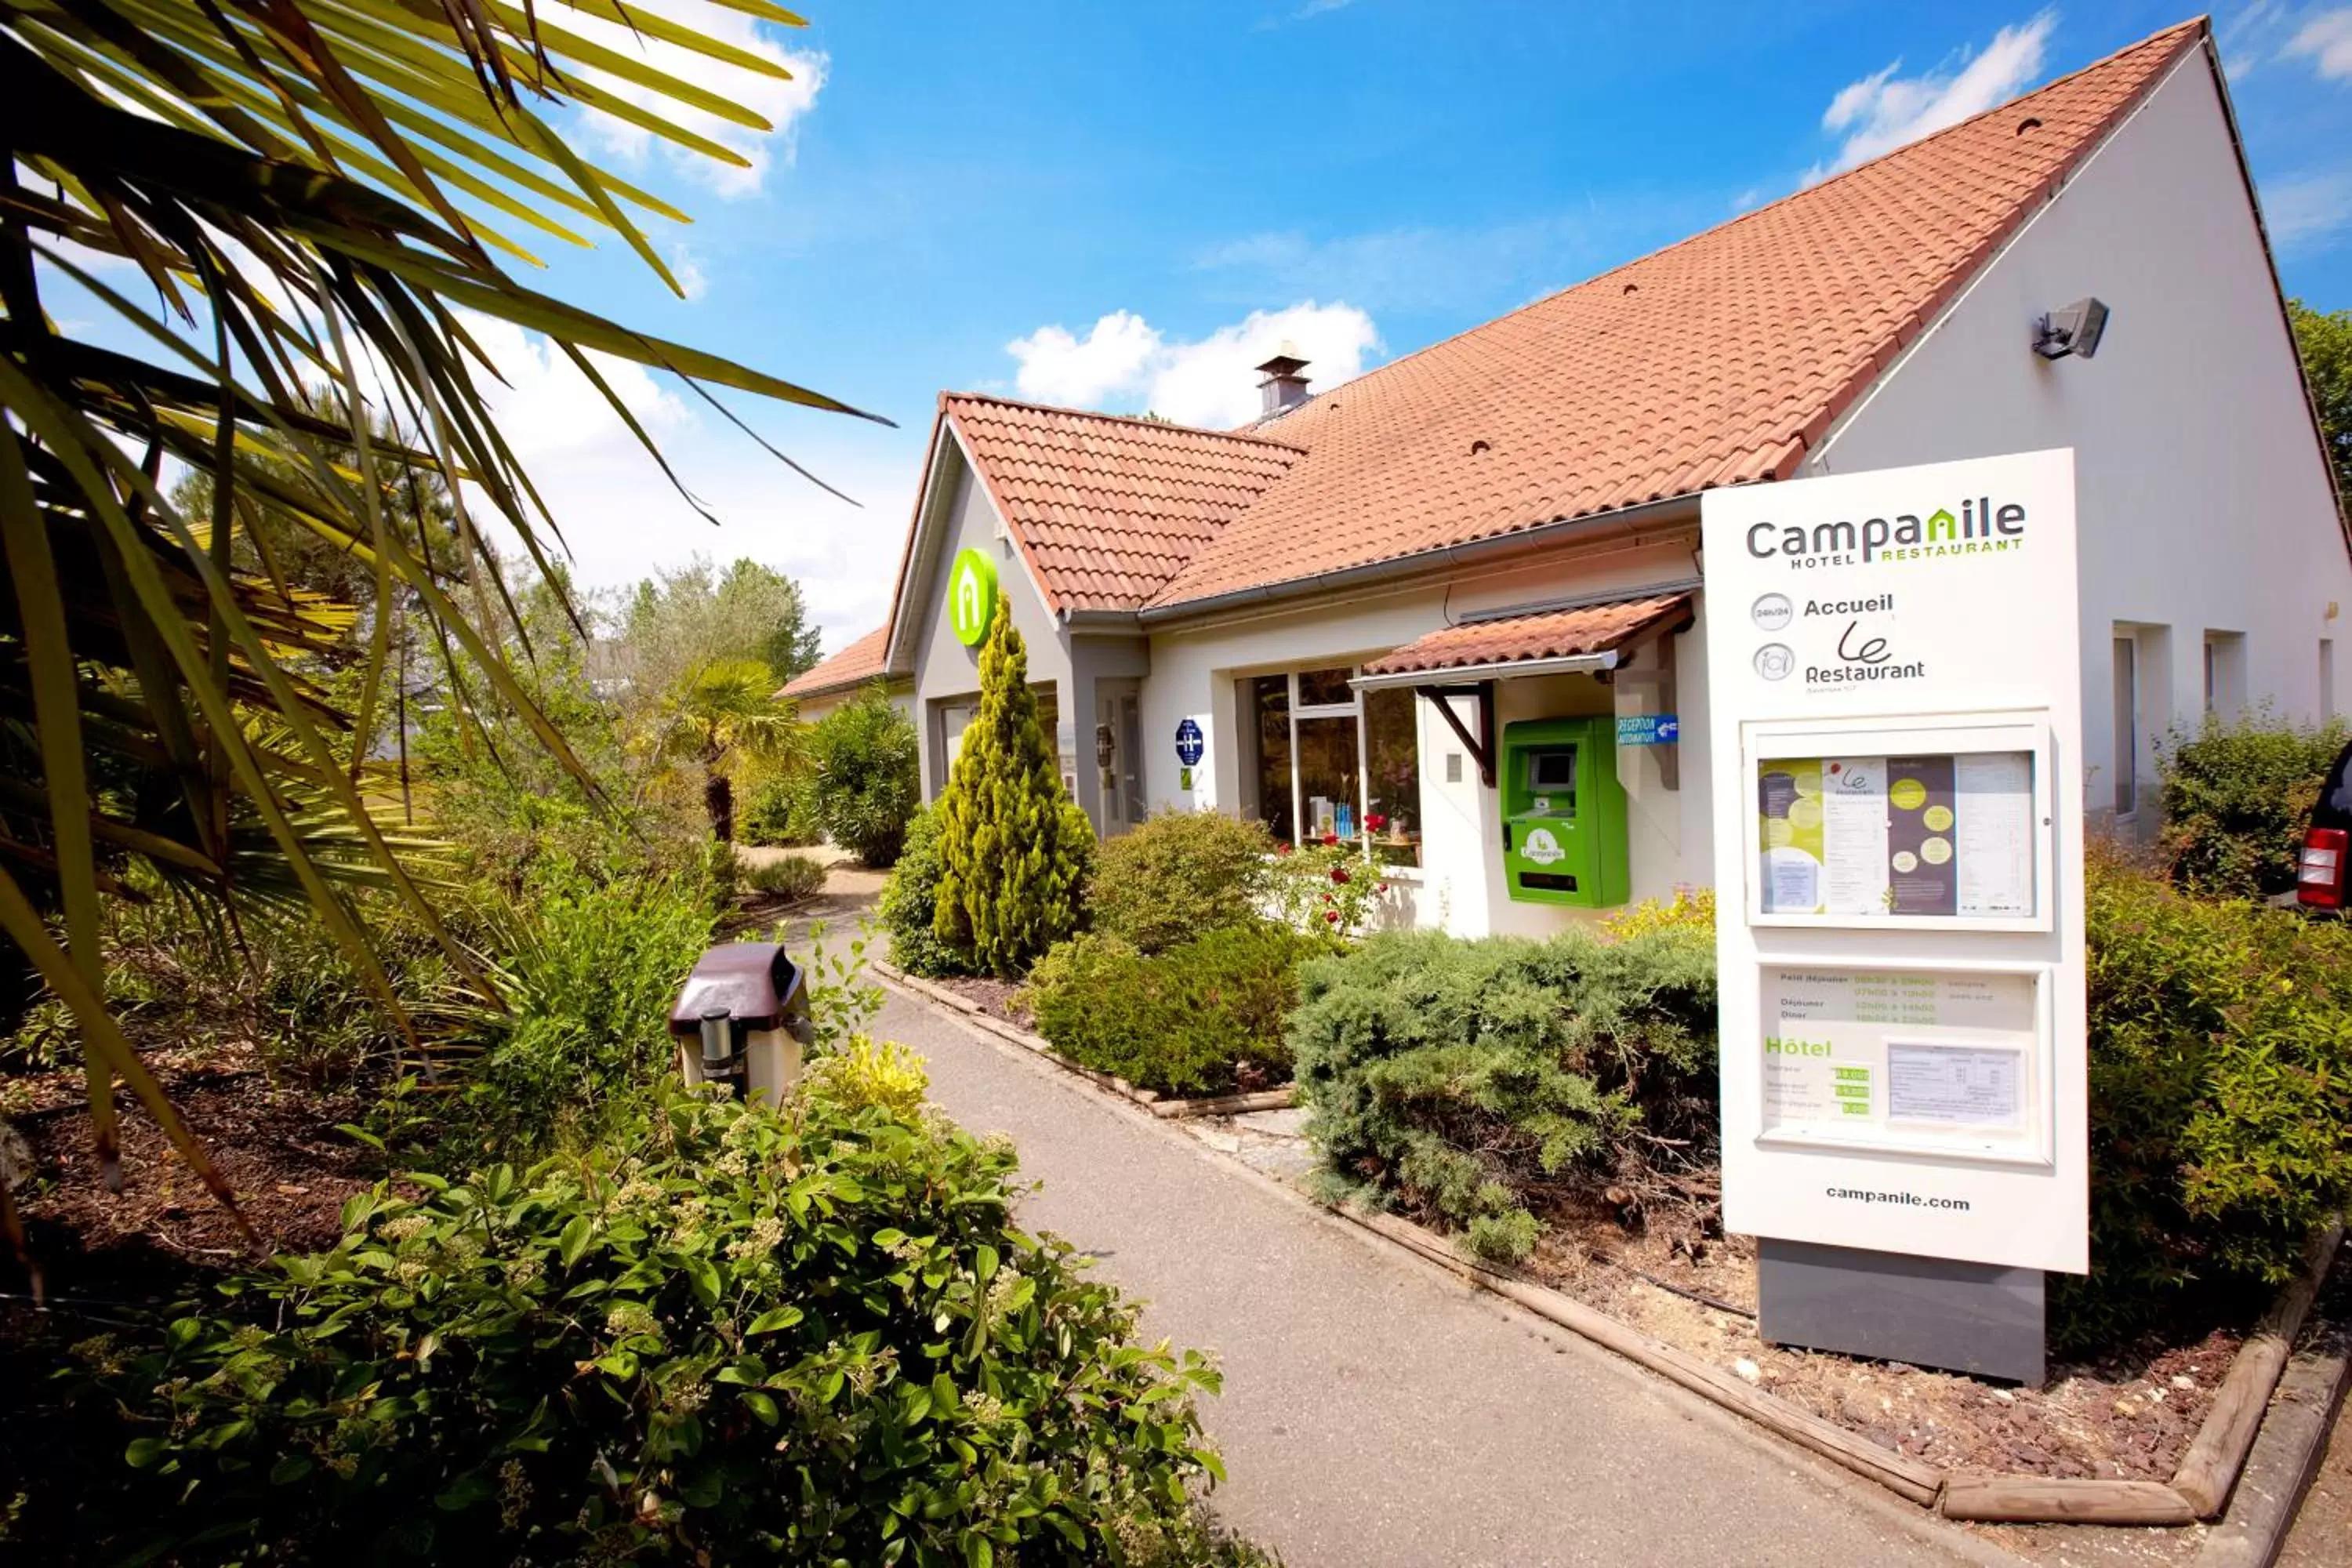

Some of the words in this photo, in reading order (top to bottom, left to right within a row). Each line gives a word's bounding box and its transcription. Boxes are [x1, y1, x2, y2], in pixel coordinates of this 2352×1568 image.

[1747, 497, 2026, 563] Campanile
[1882, 538, 2024, 562] RESTAURANT
[1791, 555, 1856, 570] HOTEL
[1804, 594, 1893, 617] Accueil
[1838, 620, 1892, 664] Le
[1806, 661, 1926, 684] Restaurant
[1766, 1035, 1832, 1057] Hôtel
[1826, 1185, 1970, 1211] campanile.com
